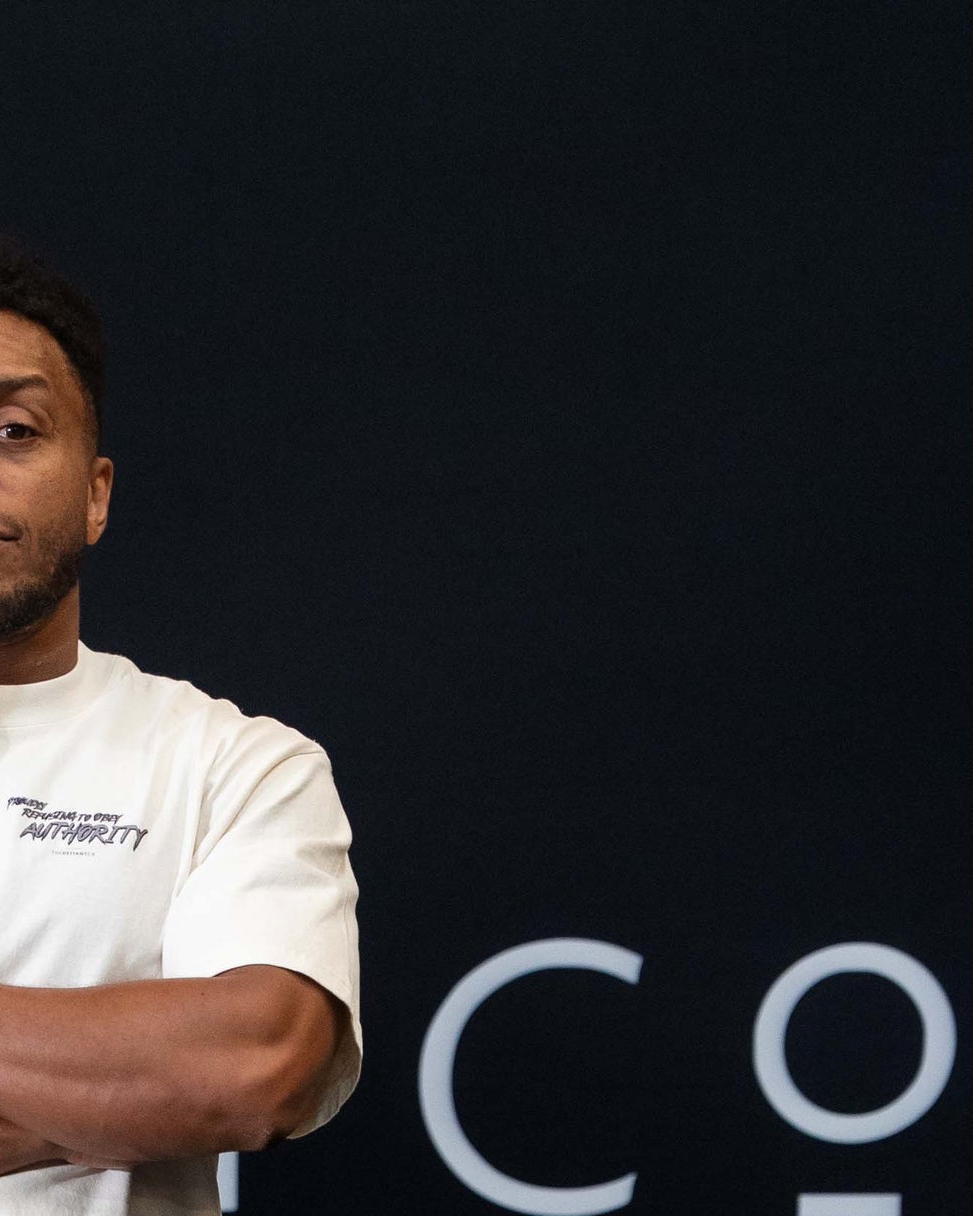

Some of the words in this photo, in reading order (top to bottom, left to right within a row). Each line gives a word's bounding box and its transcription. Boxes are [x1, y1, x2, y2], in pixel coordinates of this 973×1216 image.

[78, 813, 93, 822] TO
[93, 813, 122, 824] OBEY
[20, 822, 148, 851] AUTHORITY
